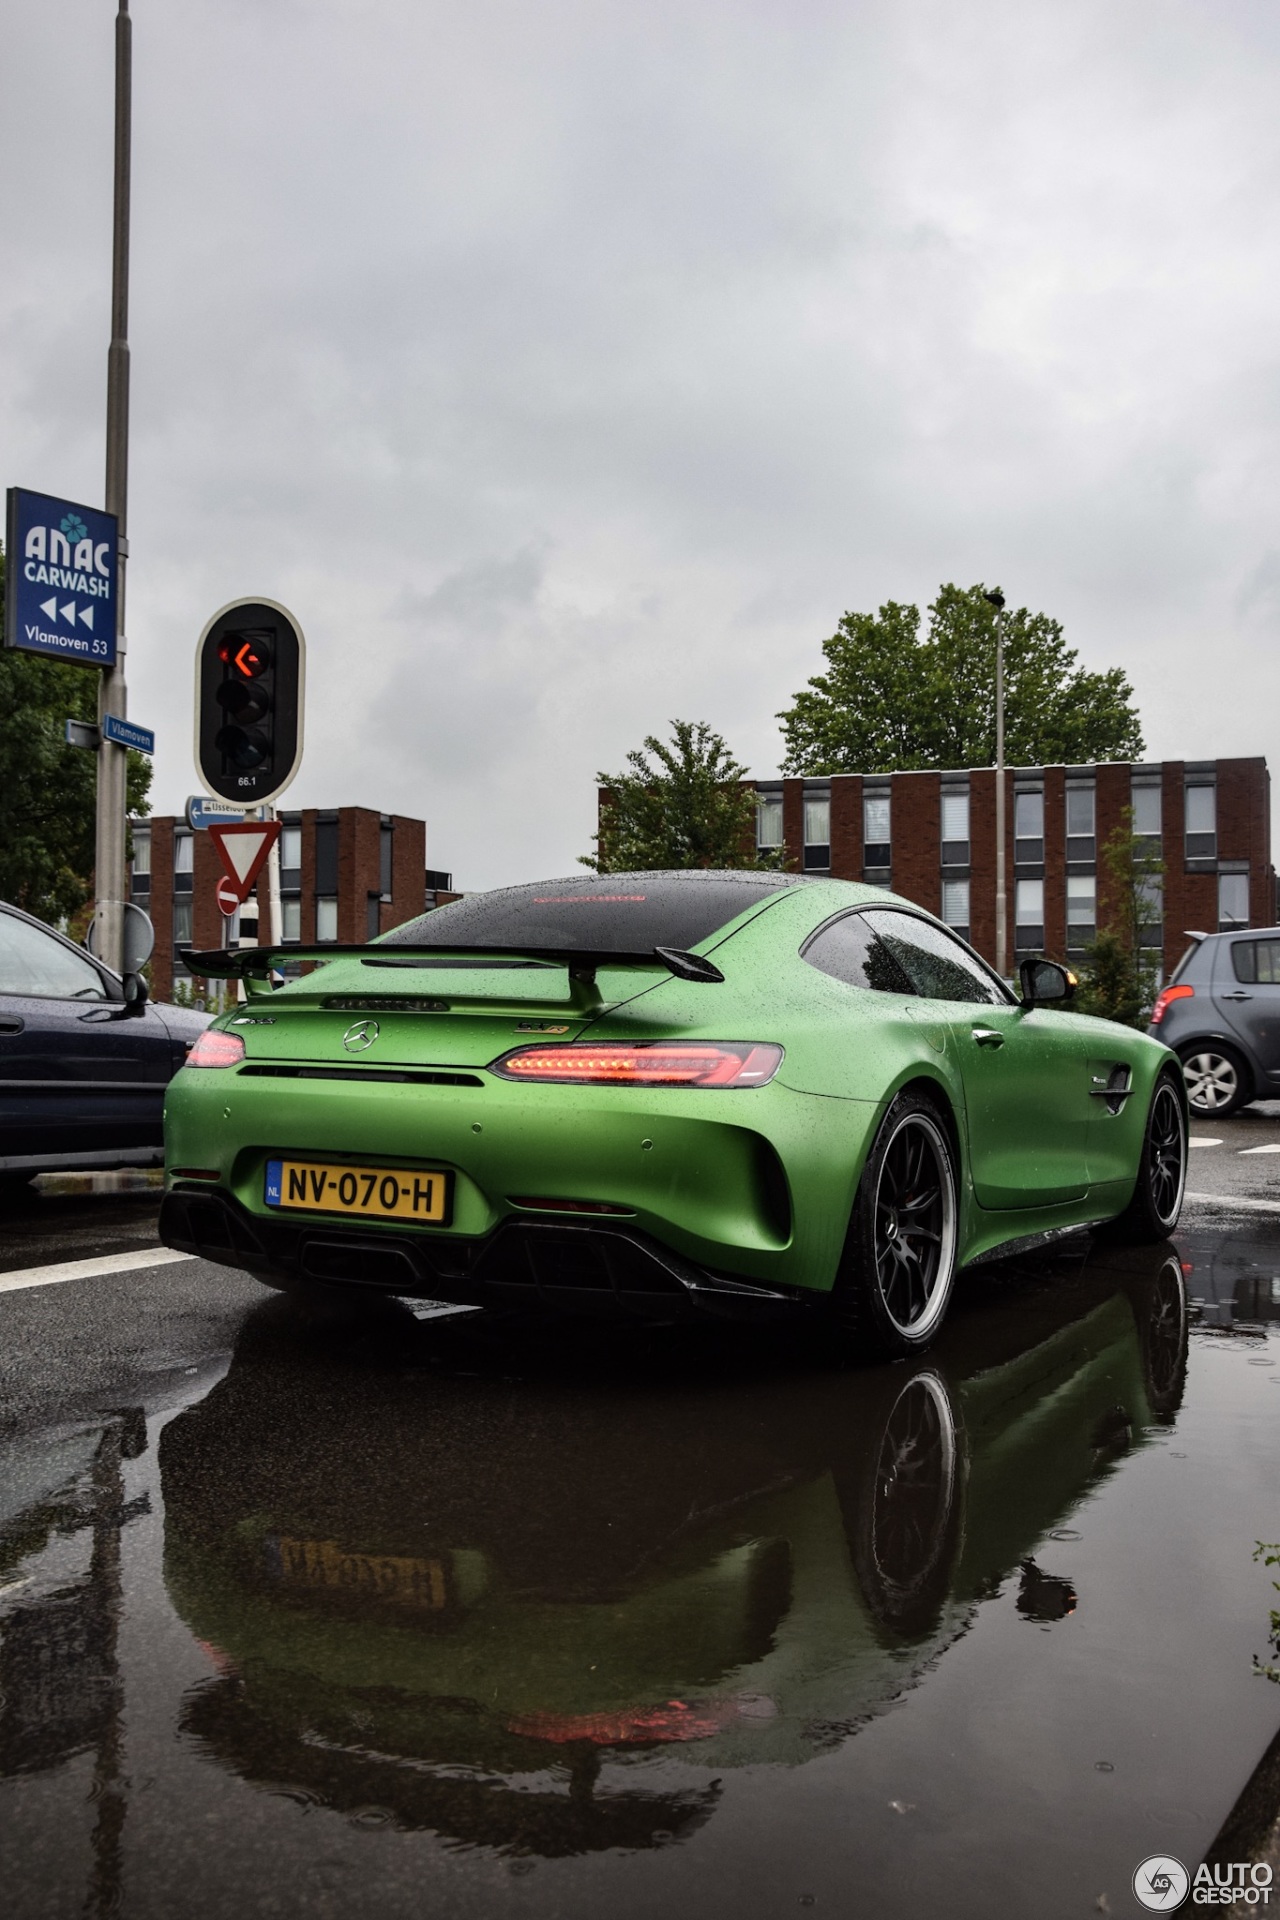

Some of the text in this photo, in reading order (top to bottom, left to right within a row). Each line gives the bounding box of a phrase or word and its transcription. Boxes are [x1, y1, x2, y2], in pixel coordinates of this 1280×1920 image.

[24, 561, 110, 600] CARWASH
[25, 624, 108, 656] Vlamoven 53
[112, 721, 151, 747] Vlamoven
[238, 776, 256, 787] 66.1
[268, 1186, 280, 1197] NL
[289, 1168, 433, 1213] NV-070-H
